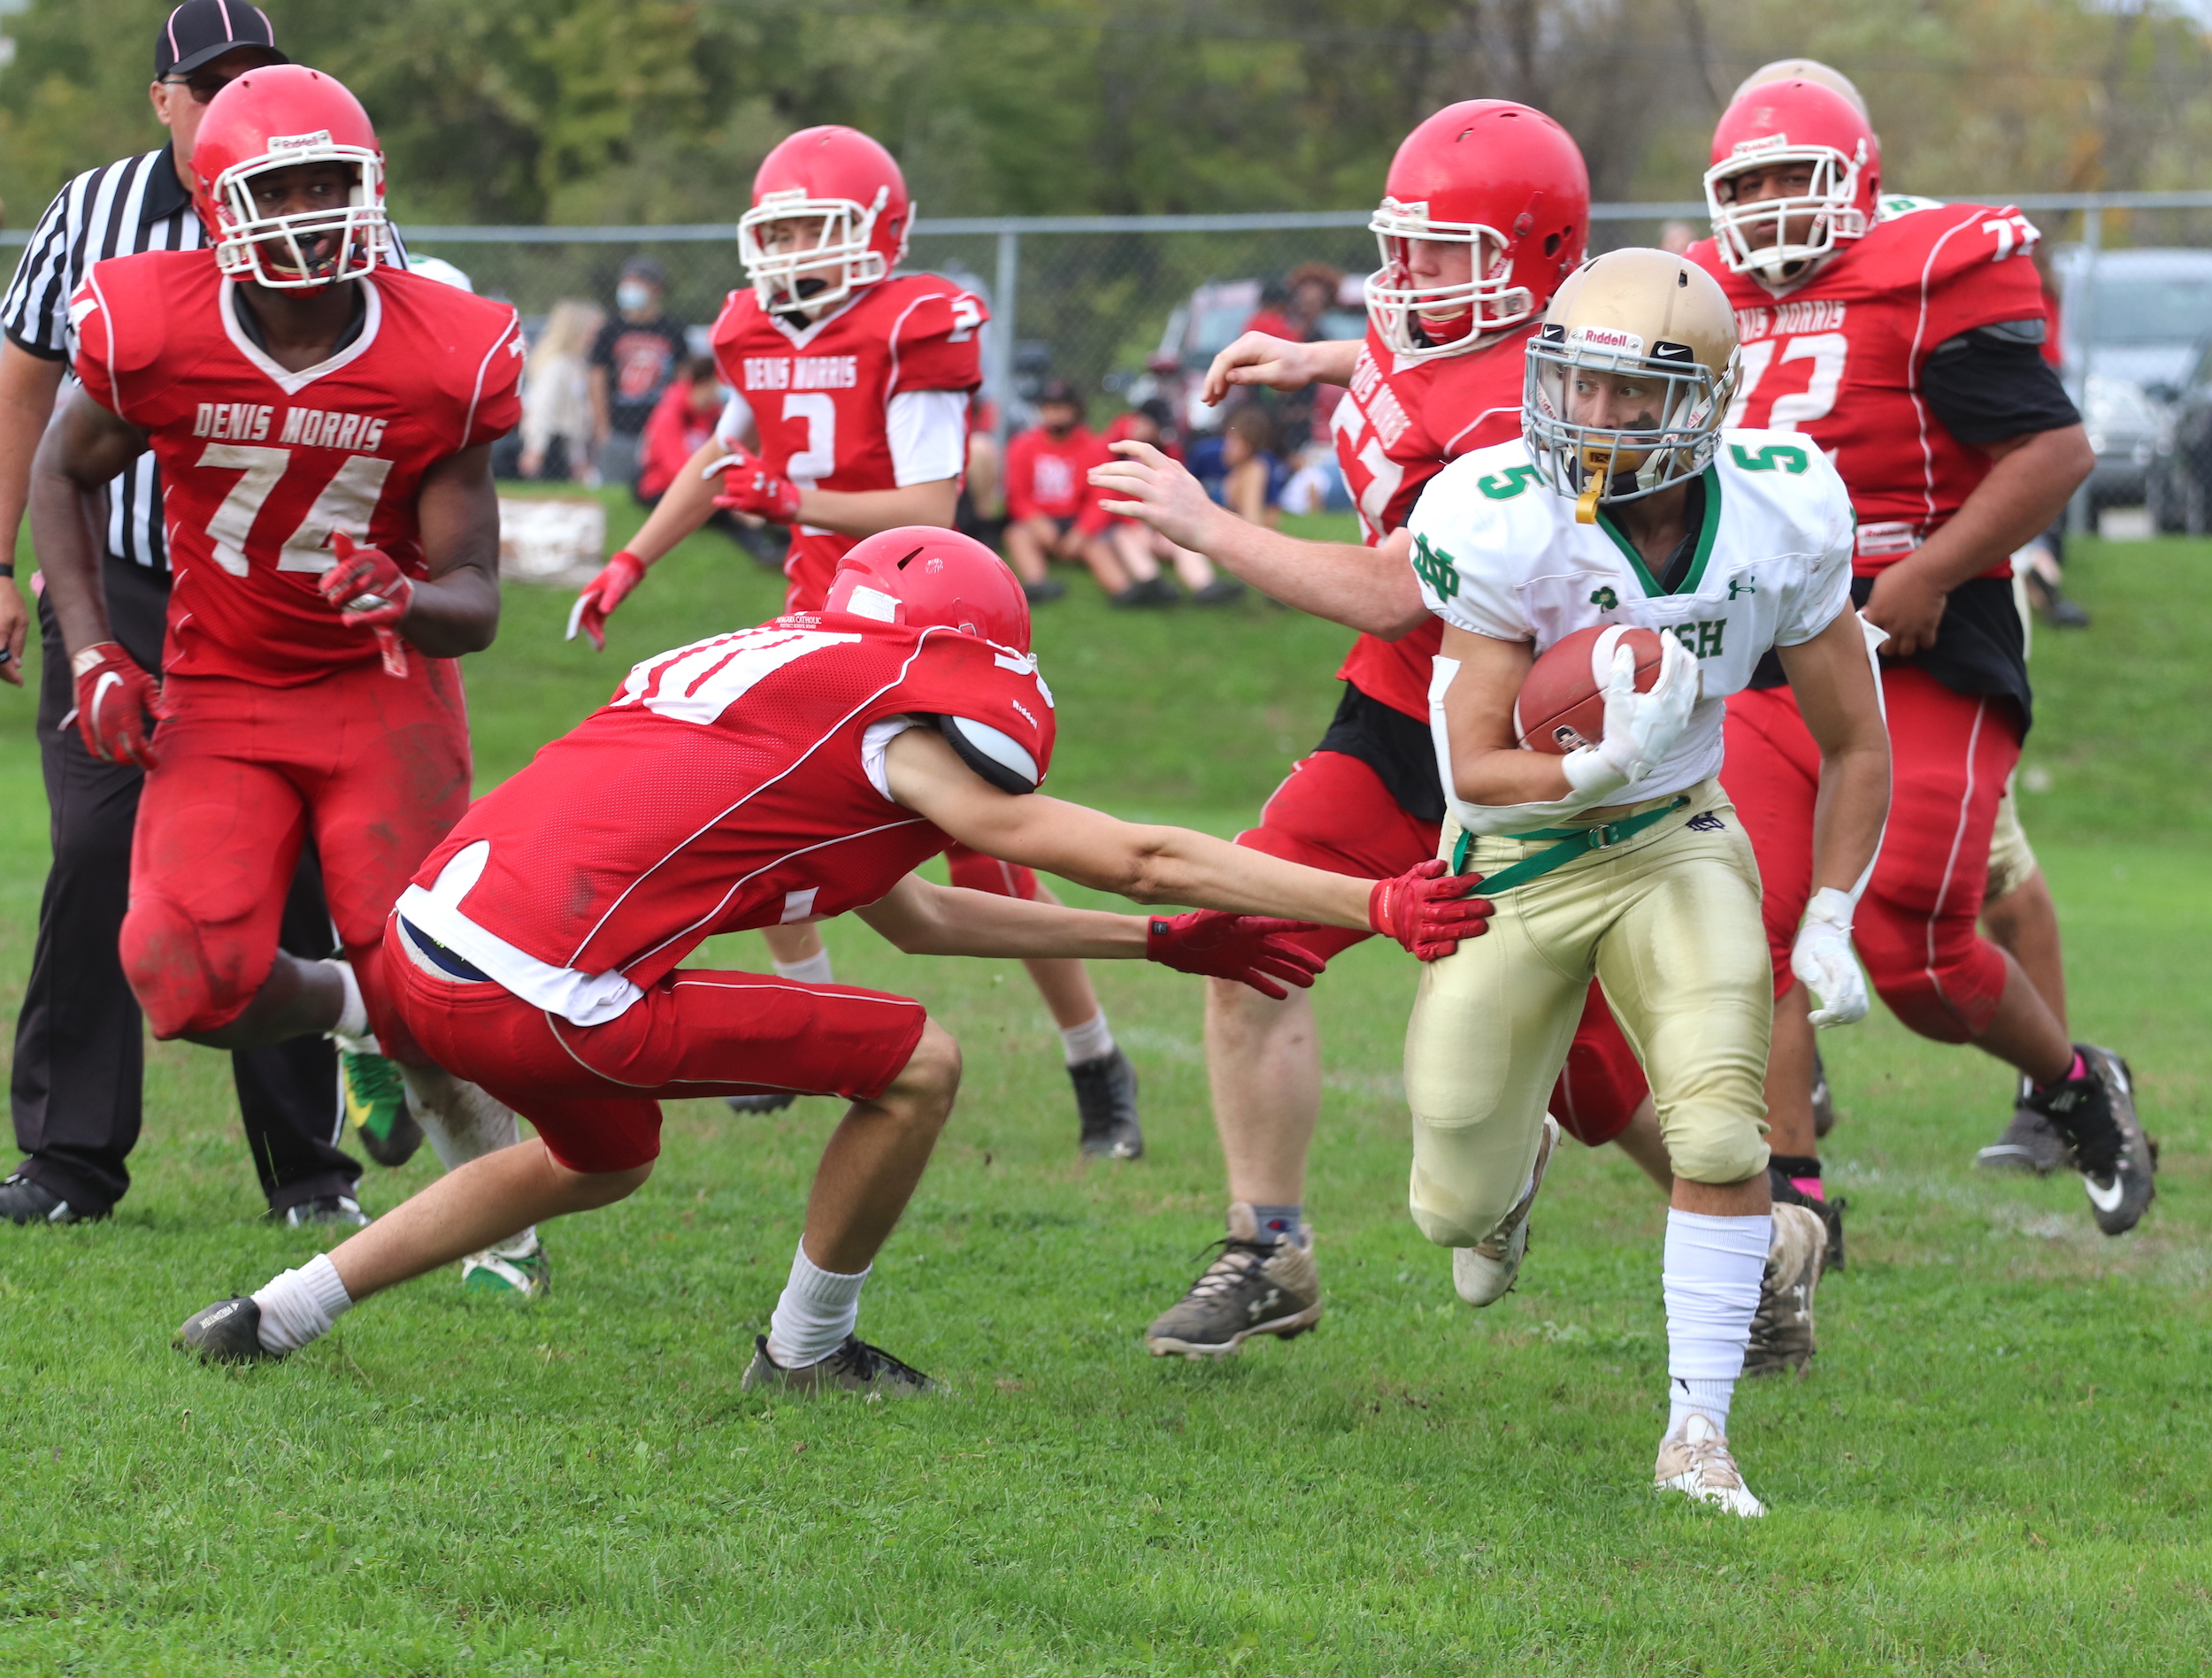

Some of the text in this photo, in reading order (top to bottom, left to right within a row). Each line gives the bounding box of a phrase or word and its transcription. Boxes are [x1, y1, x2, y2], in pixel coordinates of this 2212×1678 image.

[947, 299, 982, 344] 2
[1770, 300, 1847, 336] MORRIS
[1585, 329, 1628, 347] Riddell
[743, 356, 858, 391] DENIS MORRIS
[191, 402, 390, 452] DENIS MORRIS
[1726, 443, 1812, 477] 5
[1475, 463, 1555, 502] 5
[193, 442, 396, 578] 74
[795, 616, 822, 624] CATHOLIC
[199, 1306, 234, 1329] PREDATOR
